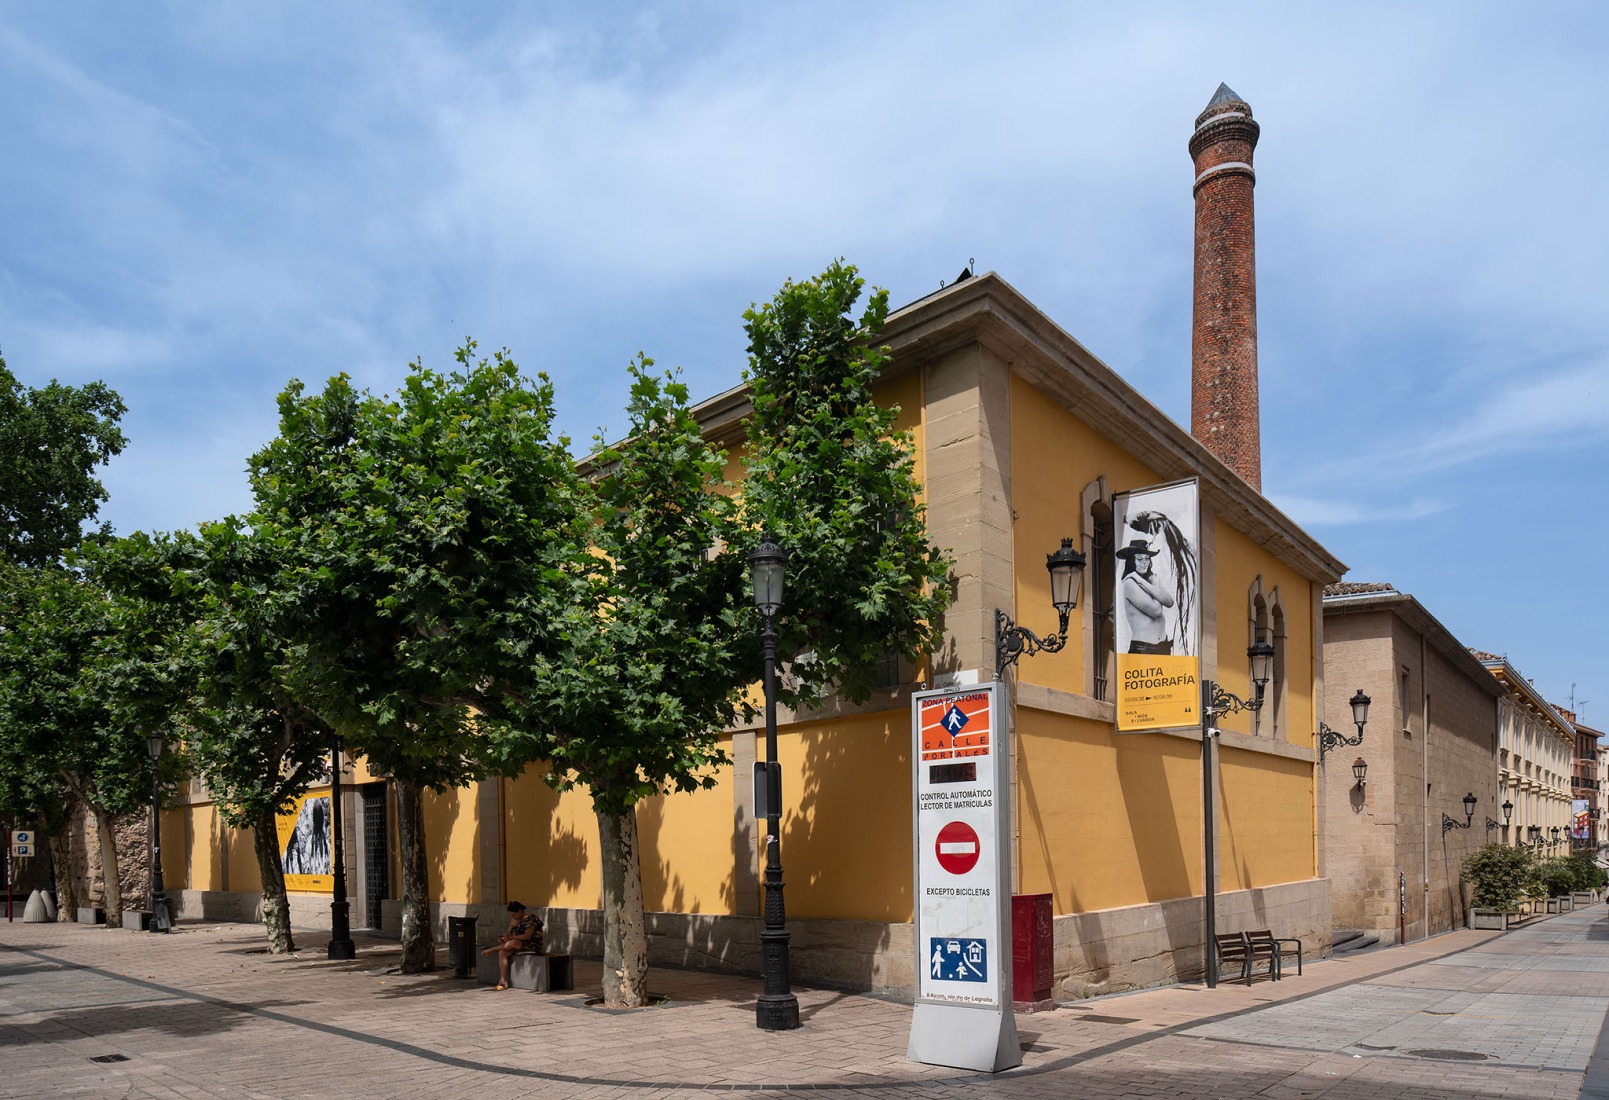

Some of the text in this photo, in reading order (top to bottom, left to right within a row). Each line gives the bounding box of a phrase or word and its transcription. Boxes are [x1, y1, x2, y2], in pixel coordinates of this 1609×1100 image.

[1124, 667, 1163, 680] COLITA
[1124, 673, 1195, 690] FOTOGRAFÍA
[922, 694, 988, 707] ZONA PEATONAL
[924, 736, 986, 749] CALLE
[920, 789, 992, 801] CONTROL AUTOMÁTICO
[920, 799, 993, 810] LECTOR DE MATRÍCULAS
[926, 888, 991, 897] EXCEPTO BICICLETAS
